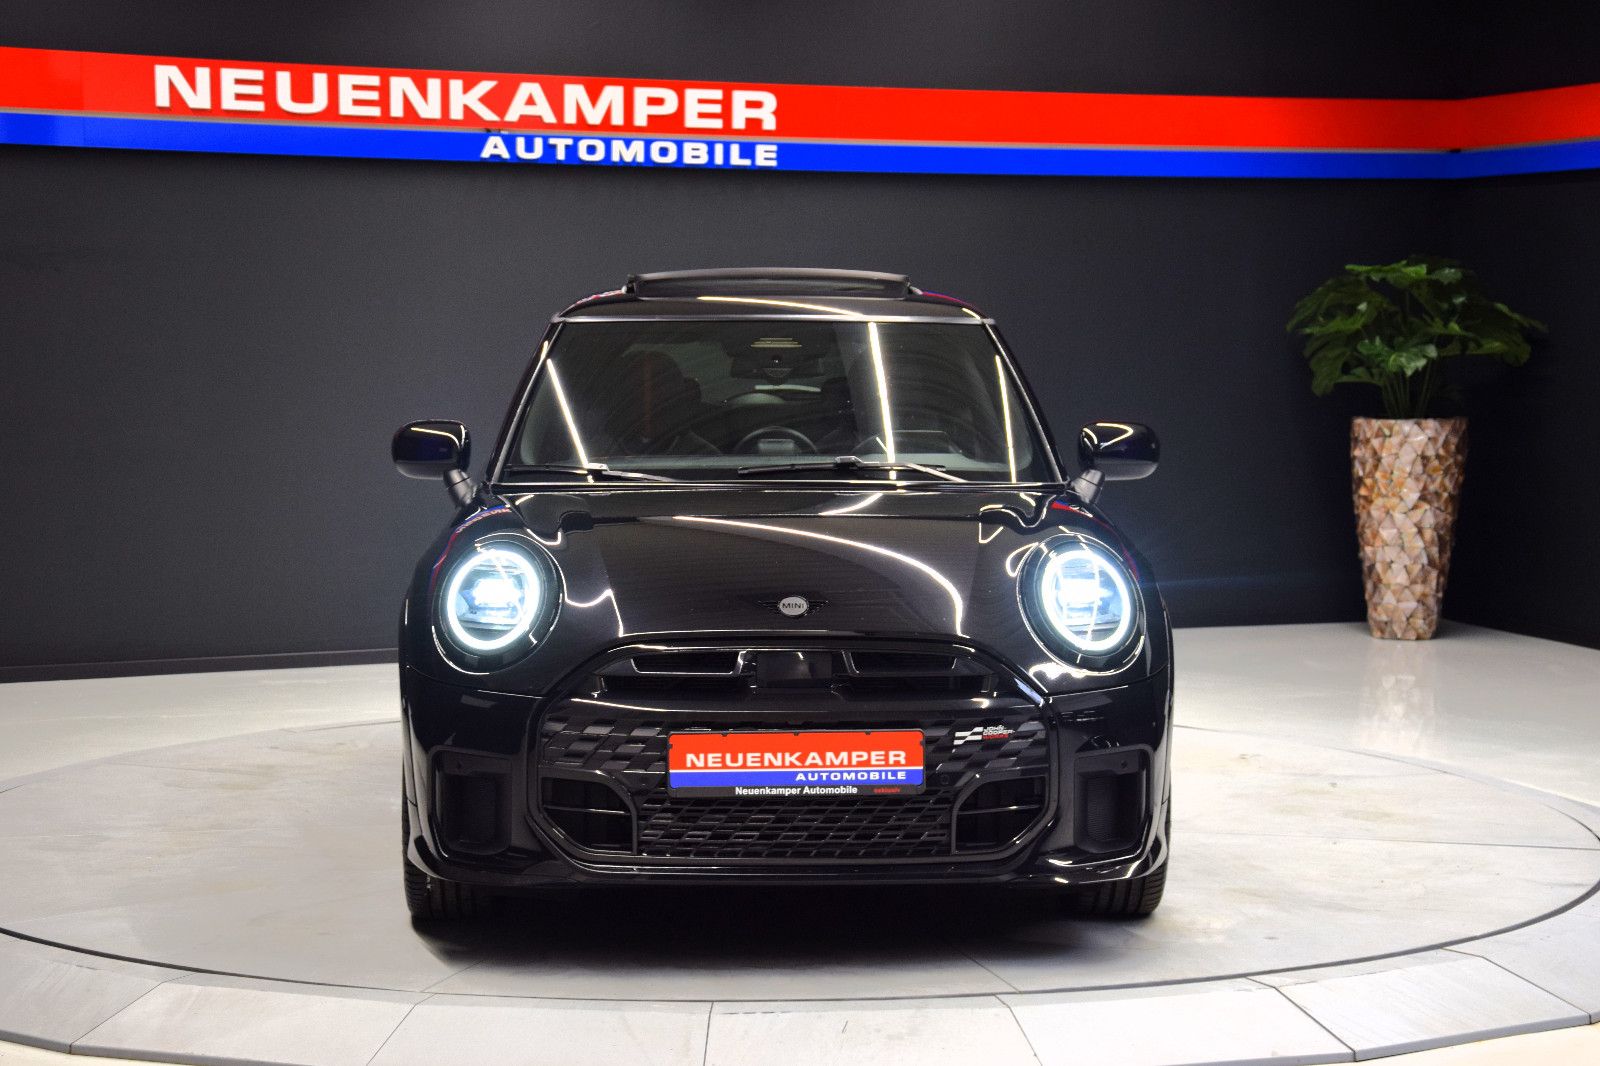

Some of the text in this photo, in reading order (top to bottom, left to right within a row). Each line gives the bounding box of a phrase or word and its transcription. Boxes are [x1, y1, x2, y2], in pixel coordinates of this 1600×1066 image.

[154, 64, 778, 131] NEUENKAMPER
[480, 135, 779, 167] AUTOMOBILE
[685, 751, 906, 768] NEUENKAMPER
[795, 771, 906, 781] AUTOMOBILE
[735, 786, 858, 797] Neuenkamper Automobile
